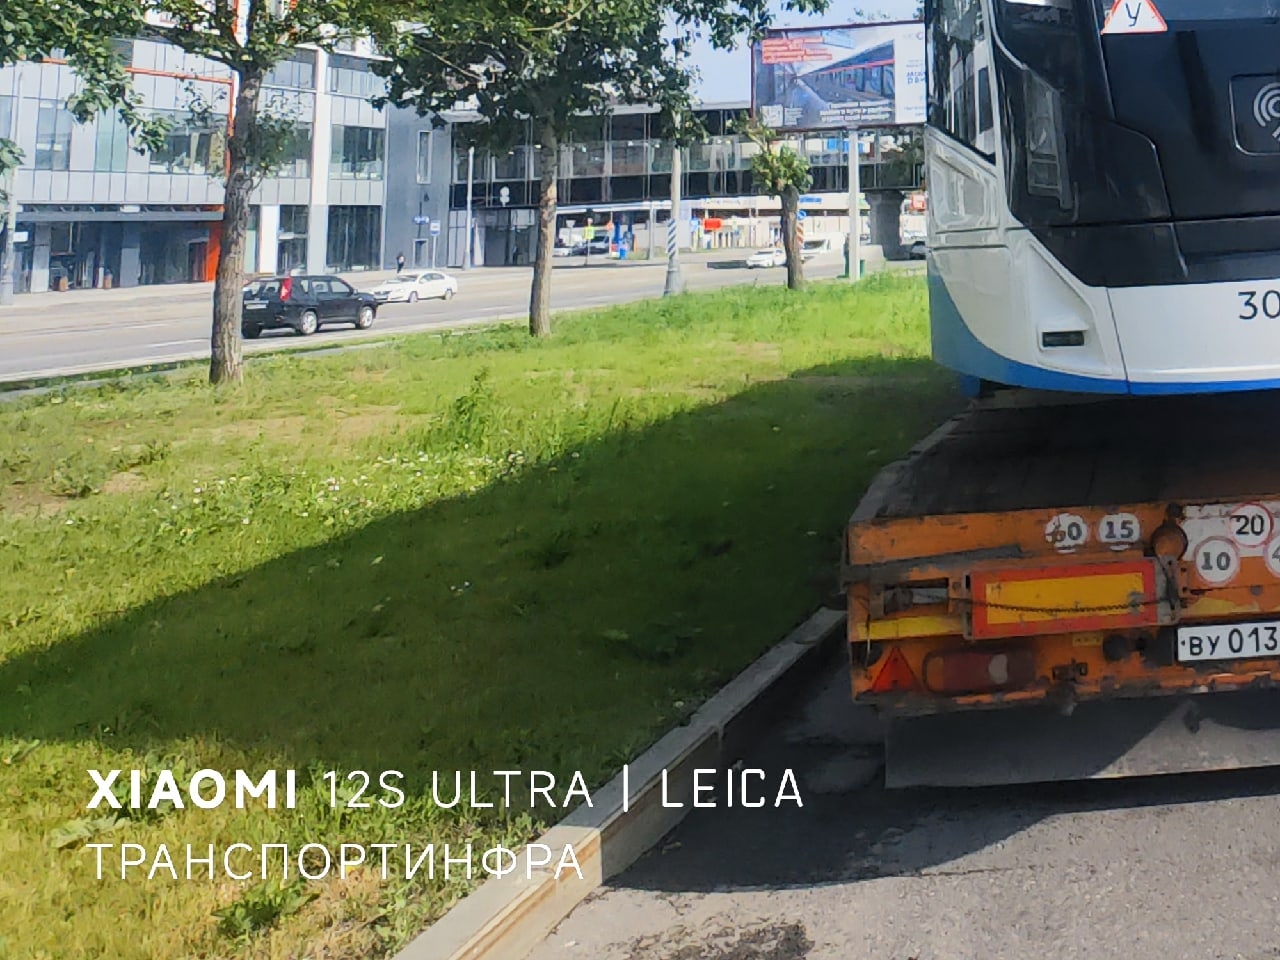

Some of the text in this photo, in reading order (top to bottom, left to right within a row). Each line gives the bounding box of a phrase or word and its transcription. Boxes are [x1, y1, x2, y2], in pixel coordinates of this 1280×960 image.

[1105, 519, 1134, 539] 15
[1234, 514, 1265, 537] 20
[1201, 551, 1231, 571] 10
